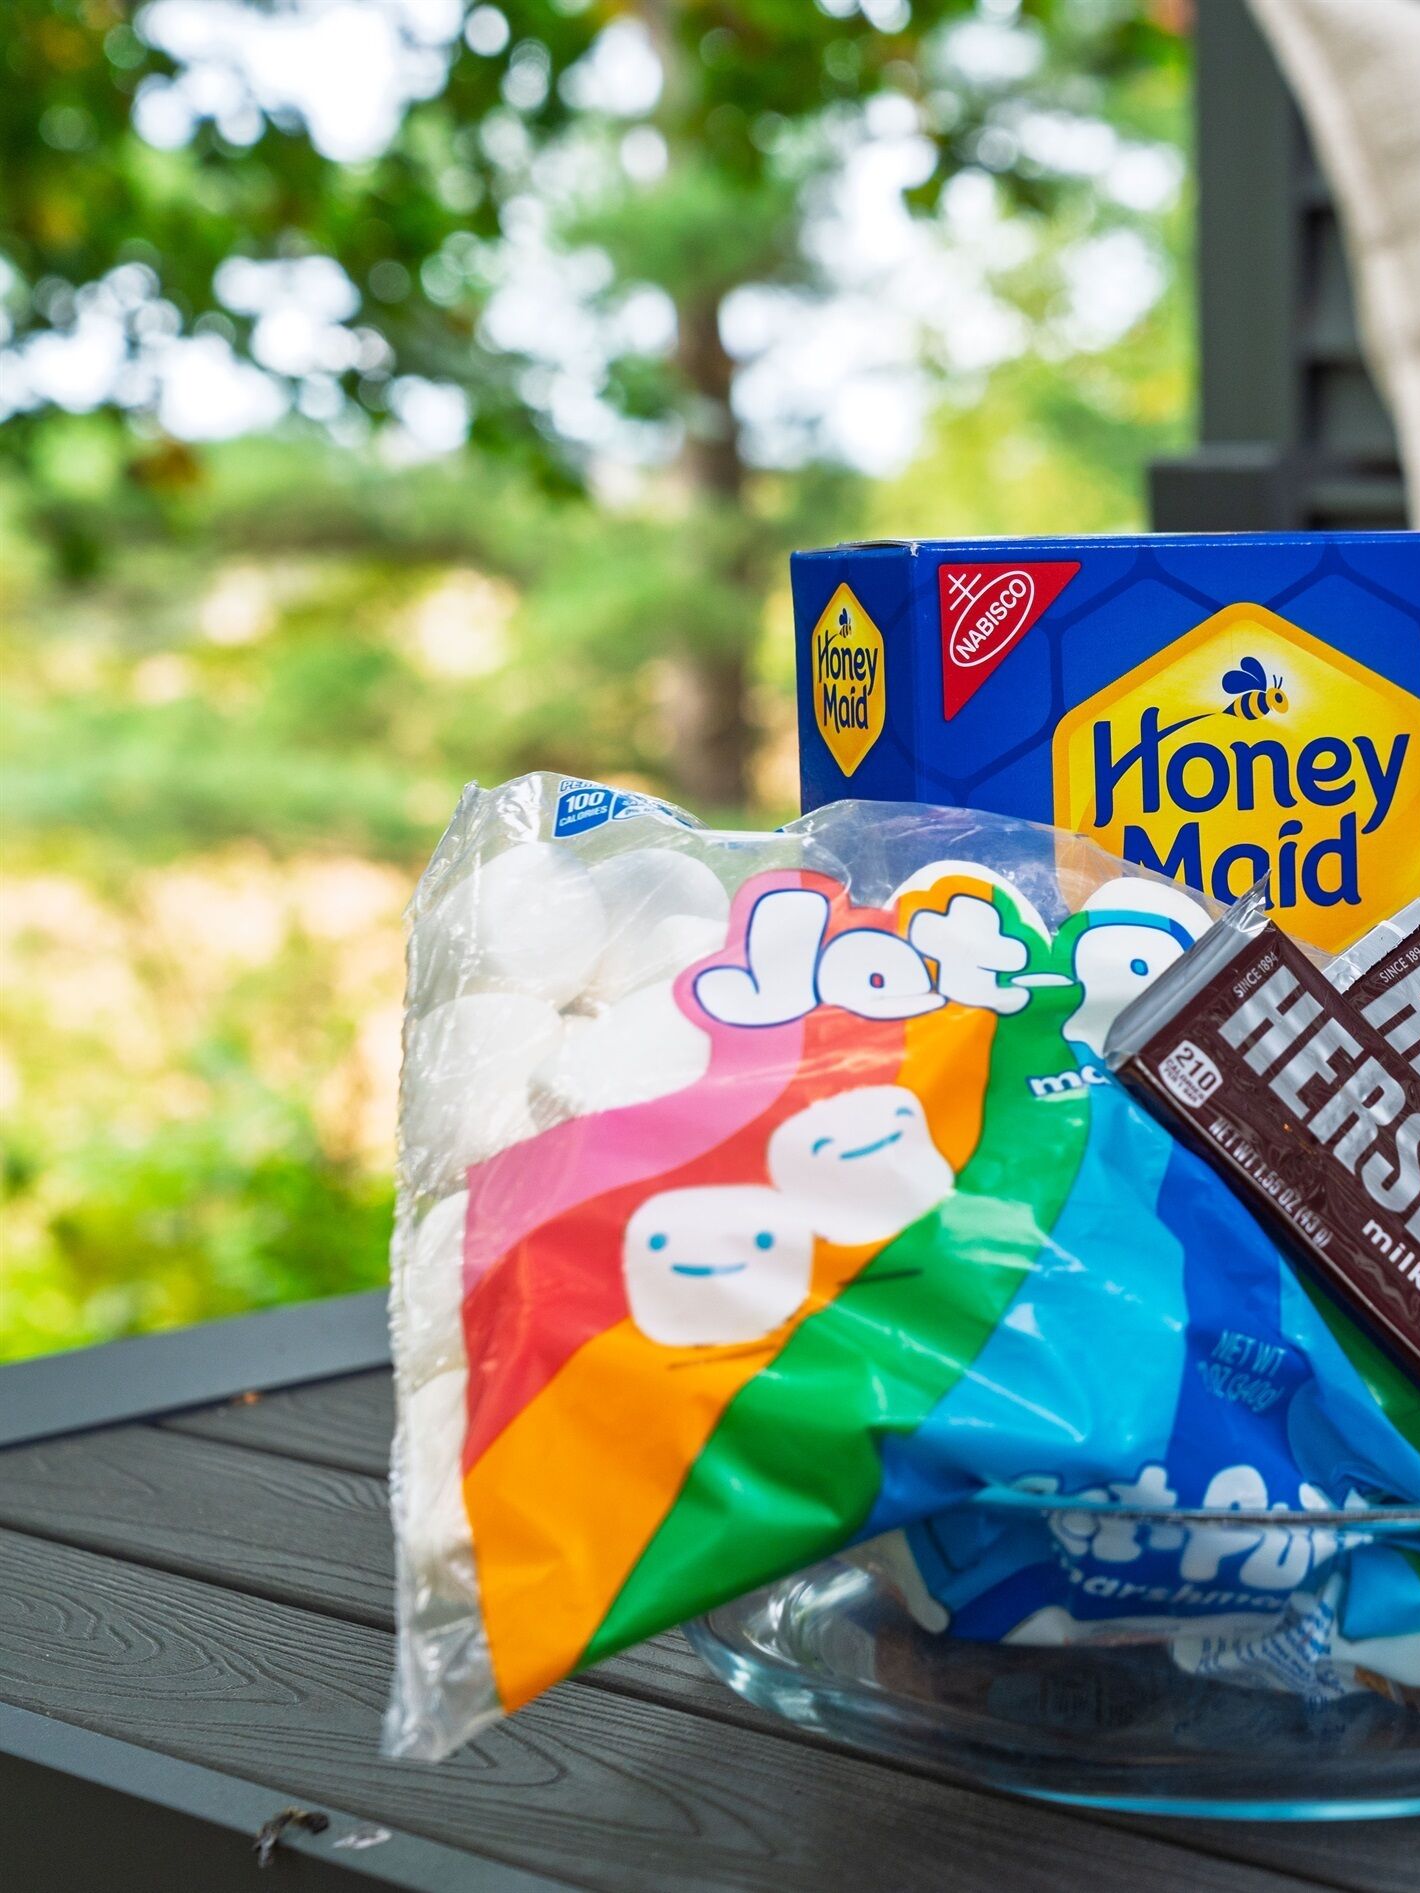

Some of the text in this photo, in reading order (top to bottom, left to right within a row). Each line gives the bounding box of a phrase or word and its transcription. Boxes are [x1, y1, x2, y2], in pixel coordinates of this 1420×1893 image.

[956, 578, 1027, 660] NABISCO
[817, 630, 878, 696] Honey
[823, 683, 869, 733] Maid
[1094, 706, 1411, 834] Honey
[559, 805, 608, 827] CALORIES
[566, 791, 606, 814] 100
[1122, 811, 1362, 907] Maid
[1232, 951, 1280, 998] SINCE 1894
[1379, 957, 1409, 984] SINCE
[1175, 1046, 1218, 1092] 210
[1209, 1116, 1239, 1149] NET
[1232, 1140, 1260, 1169] WT
[1253, 1162, 1286, 1196] 1.55
[1211, 1329, 1256, 1366] NET
[1252, 1341, 1287, 1377] WT
